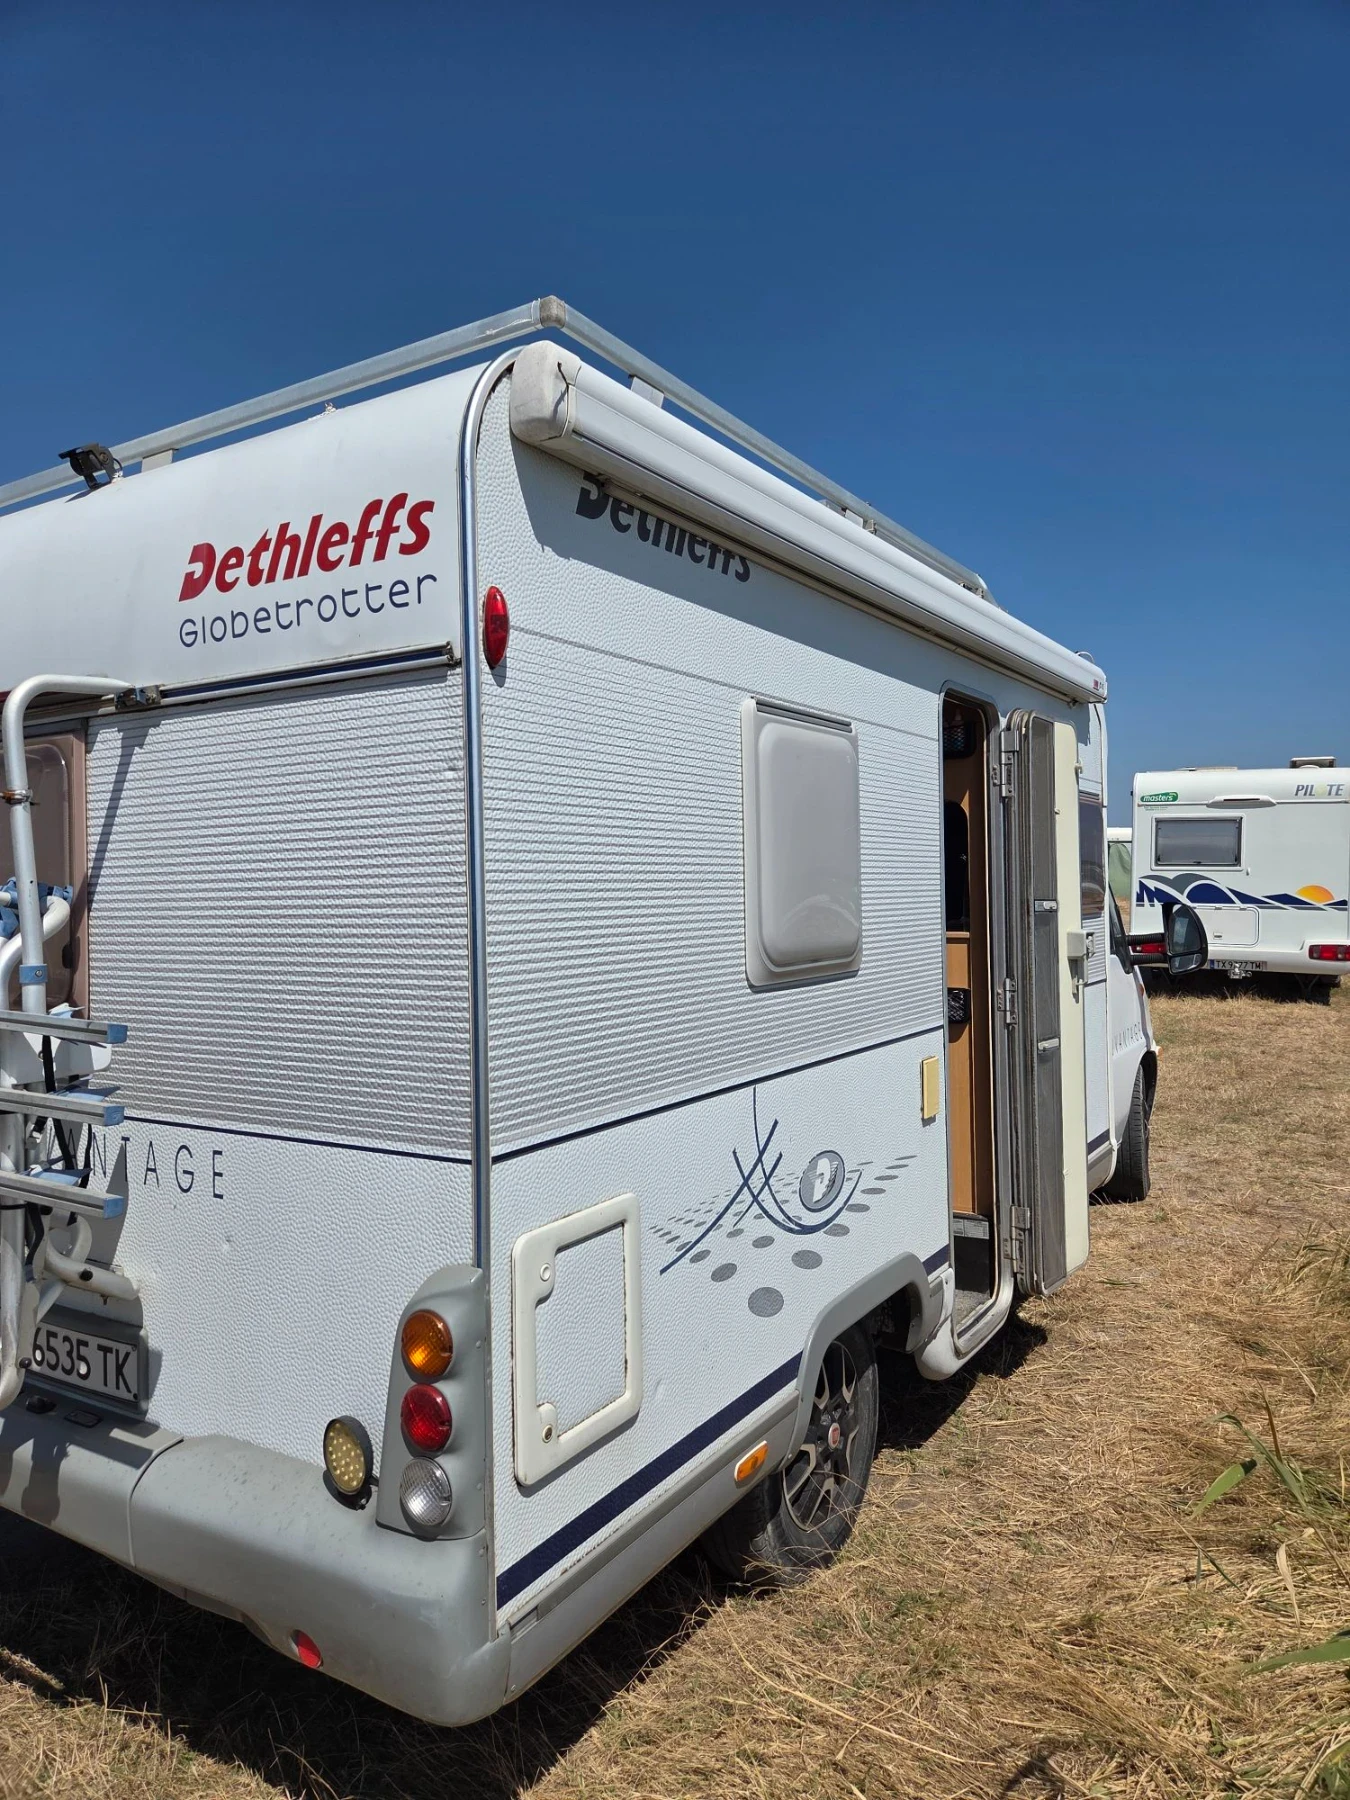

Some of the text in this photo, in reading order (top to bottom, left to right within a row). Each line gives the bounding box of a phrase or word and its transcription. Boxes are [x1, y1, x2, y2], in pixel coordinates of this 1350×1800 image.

[178, 492, 435, 602] Dethleffs
[179, 573, 438, 648] Globetrotter
[1143, 794, 1174, 802] masters
[32, 1326, 132, 1394] 6535 TK
